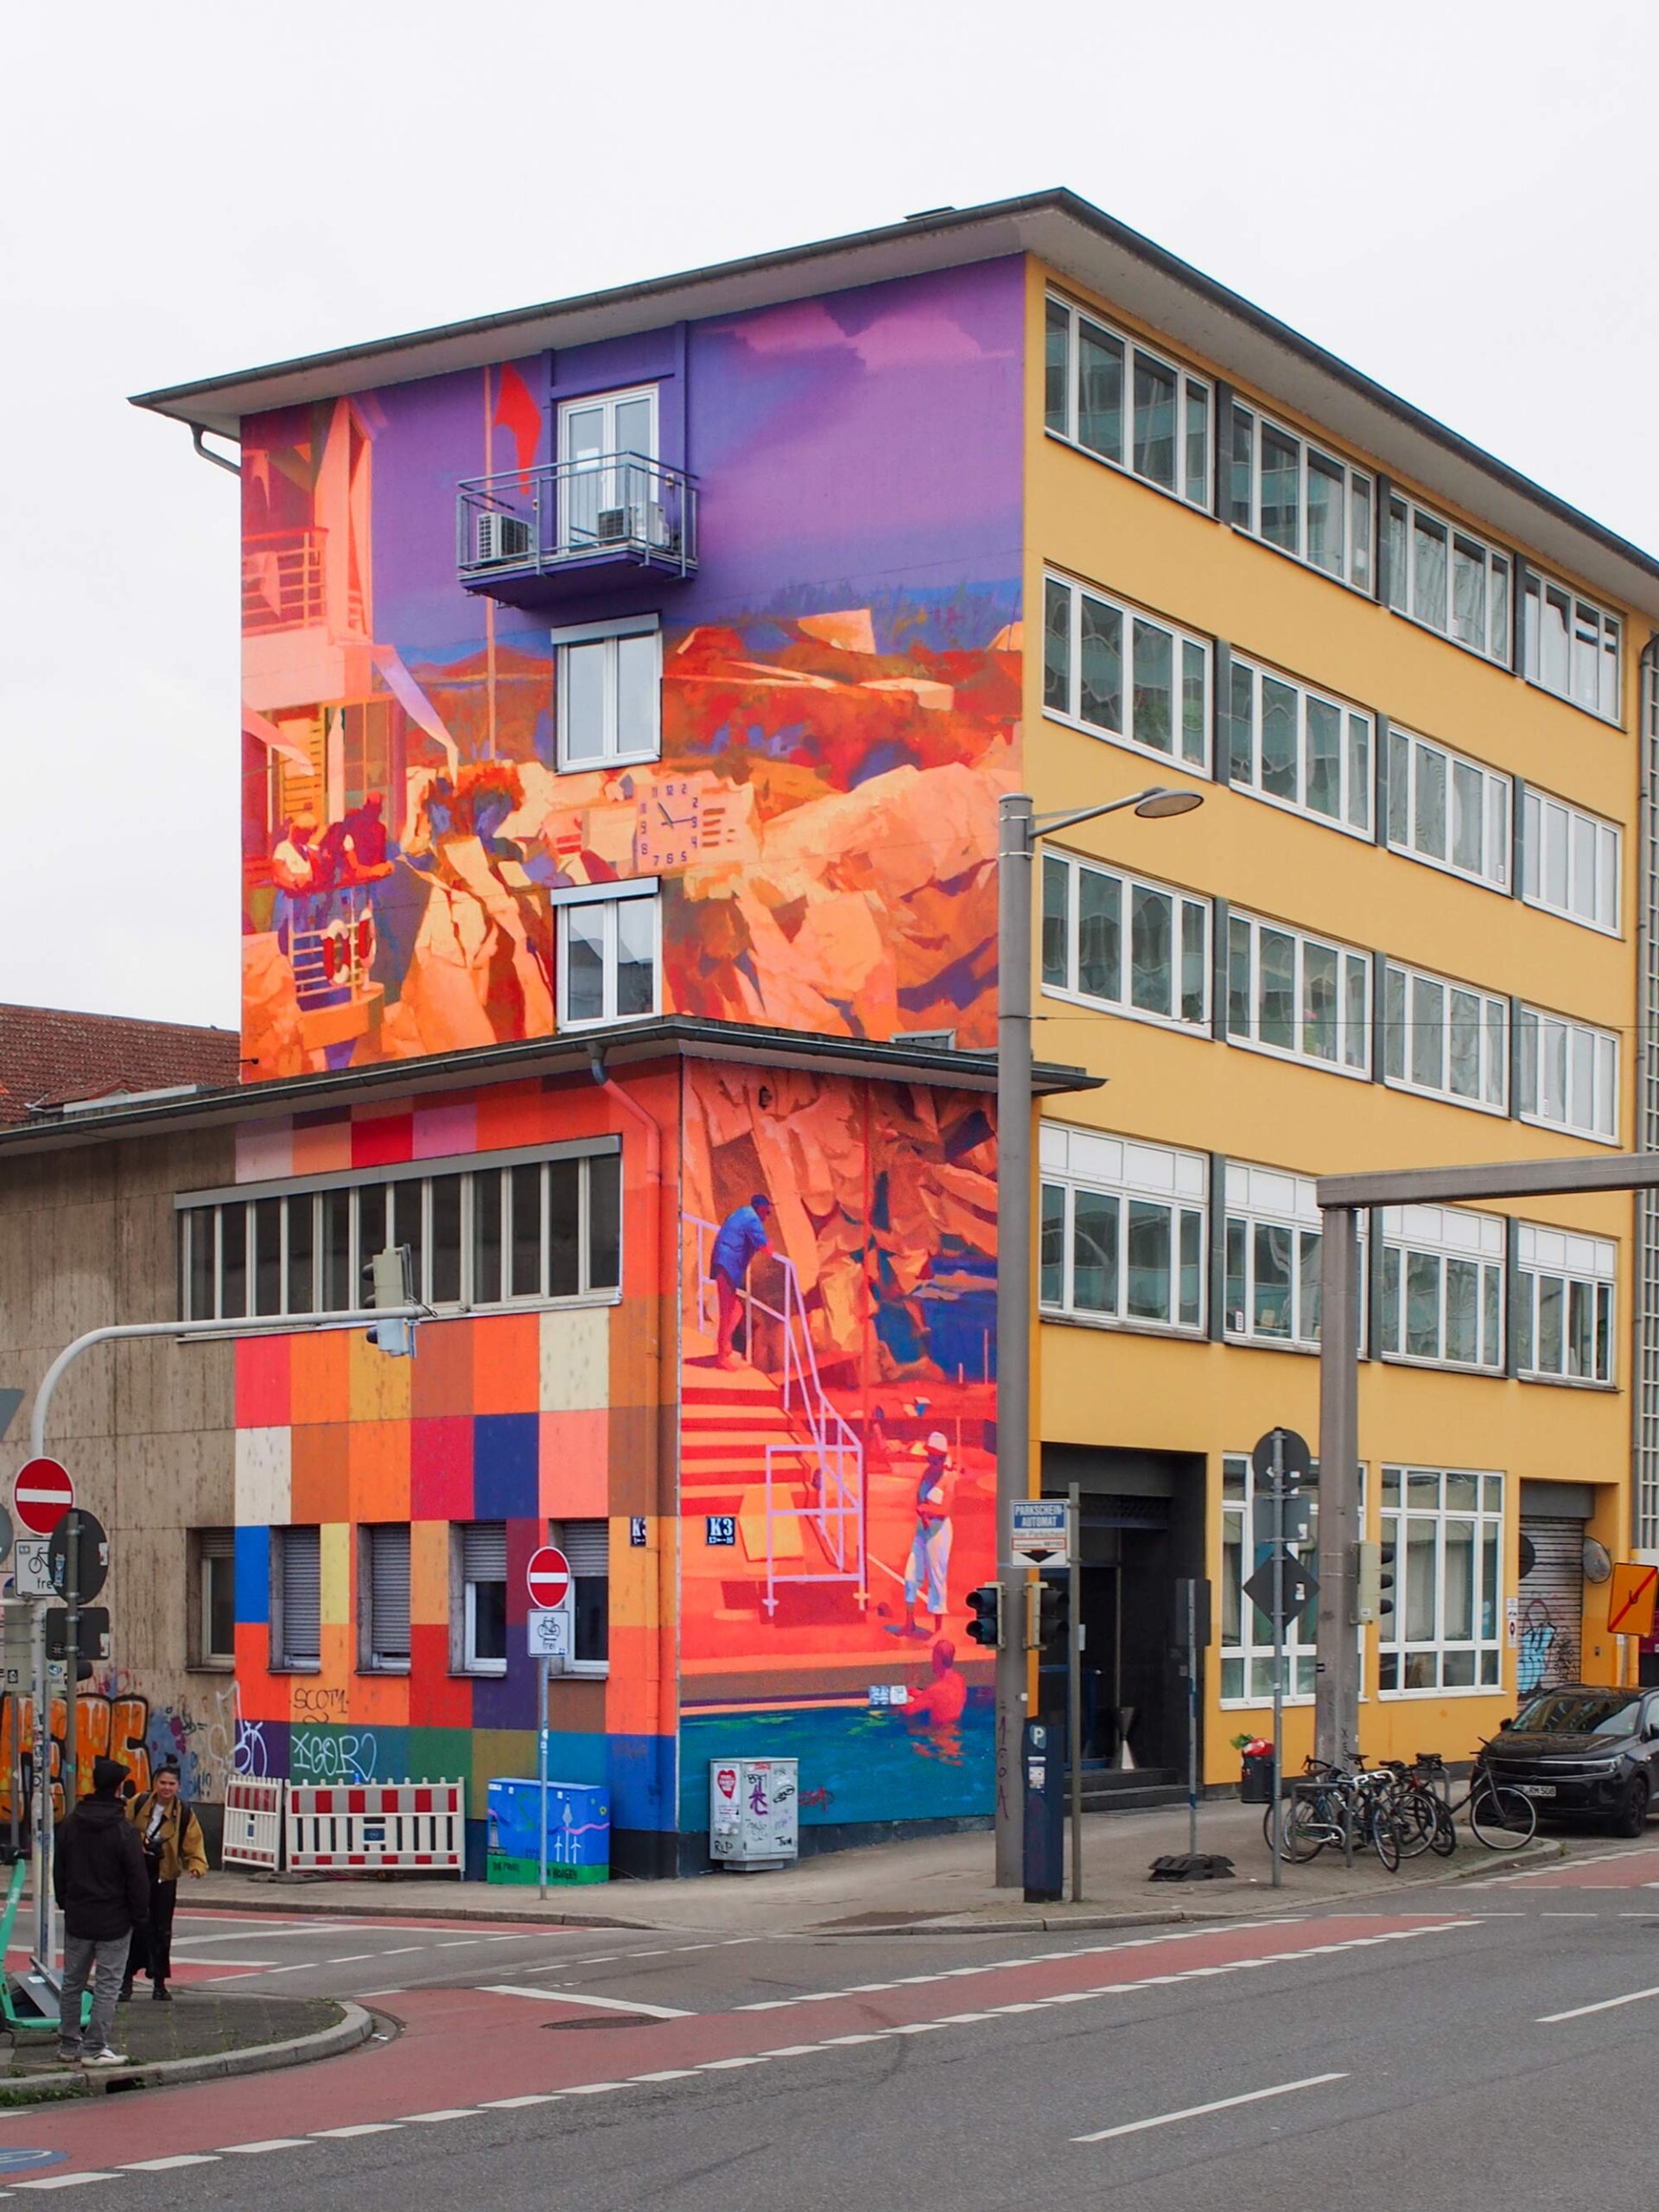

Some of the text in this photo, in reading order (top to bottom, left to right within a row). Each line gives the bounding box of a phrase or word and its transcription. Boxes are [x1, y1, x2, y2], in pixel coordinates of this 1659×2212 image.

[692, 797, 698, 808] 2
[691, 836, 697, 849] 4
[653, 850, 687, 867] 7 6 5
[1014, 1505, 1065, 1516] PARKSCHEIN-
[709, 1517, 733, 1536] K3
[1021, 1516, 1058, 1528] AUTOMAT
[37, 1577, 54, 1589] fre
[1033, 1727, 1045, 1745] P
